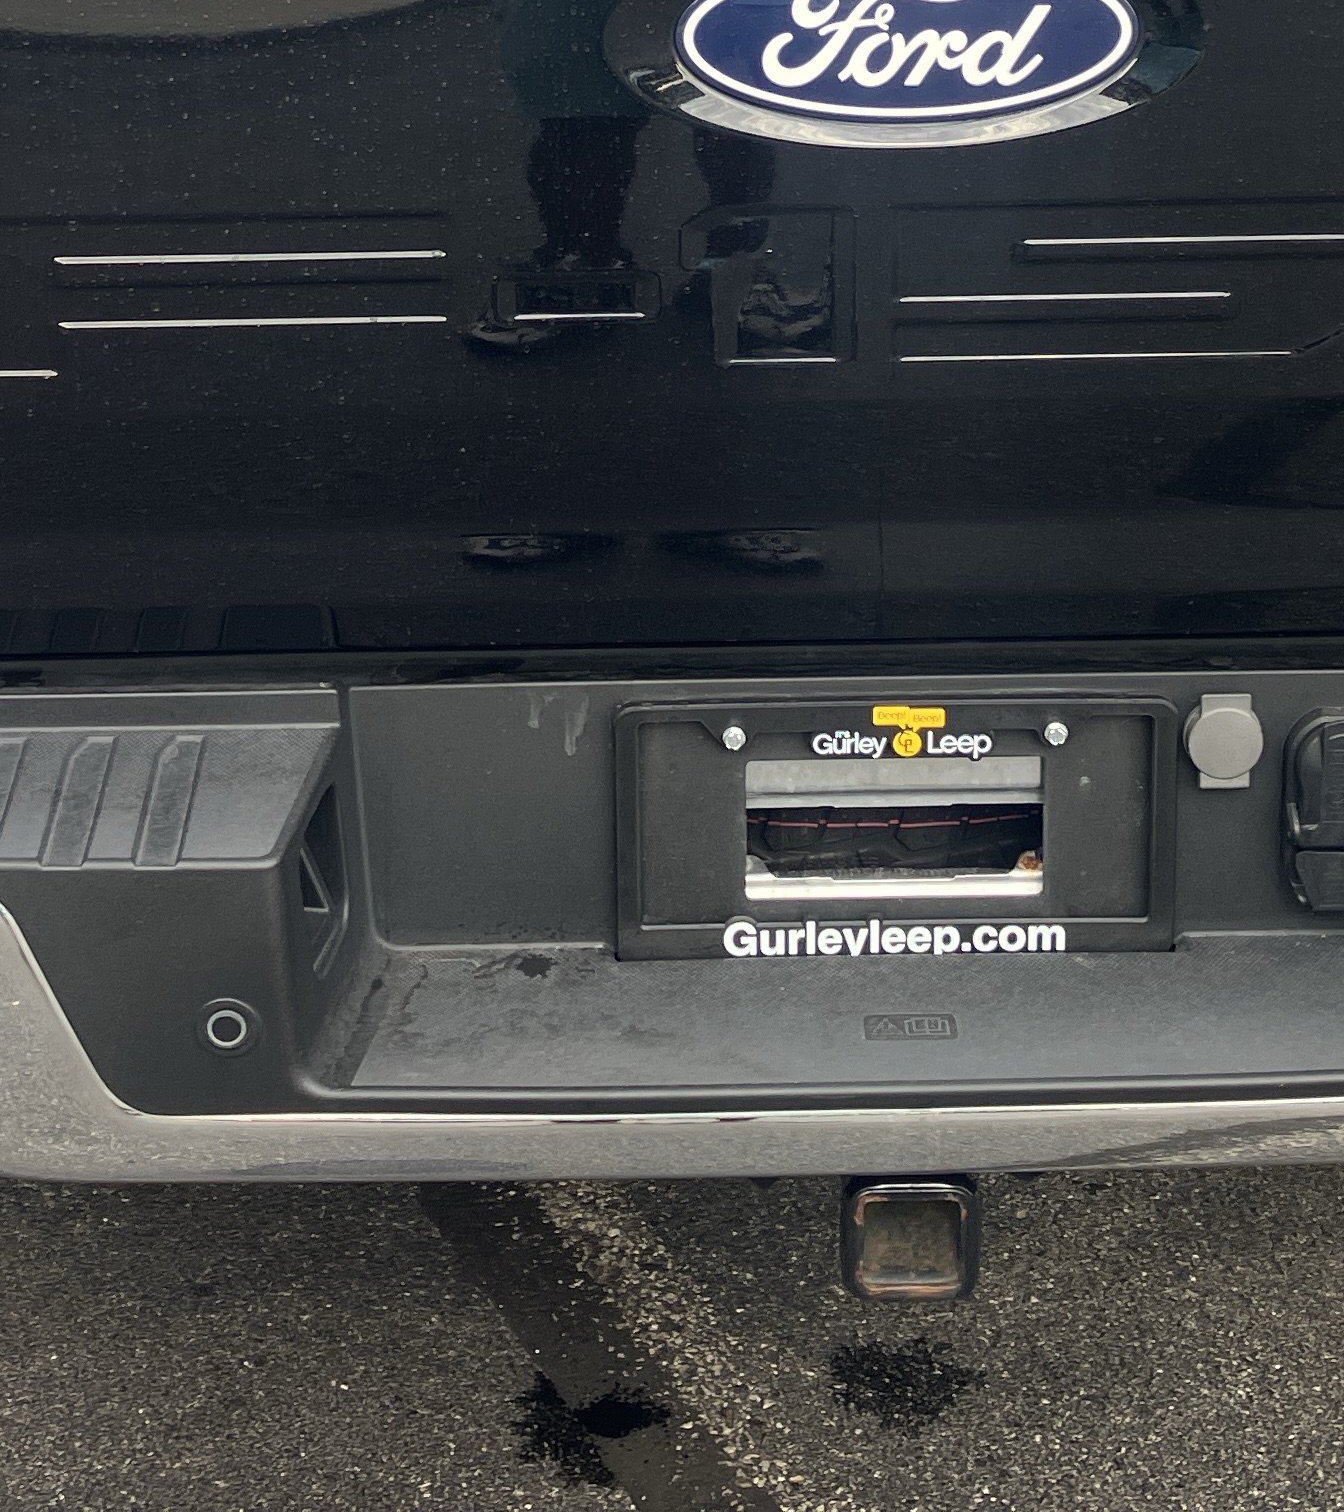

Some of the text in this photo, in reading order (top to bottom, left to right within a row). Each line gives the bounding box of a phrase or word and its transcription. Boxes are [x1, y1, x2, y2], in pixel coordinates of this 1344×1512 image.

[912, 713, 942, 724] Beep!
[927, 730, 992, 759] Leep
[723, 919, 1066, 957] Gurleyleep.com
